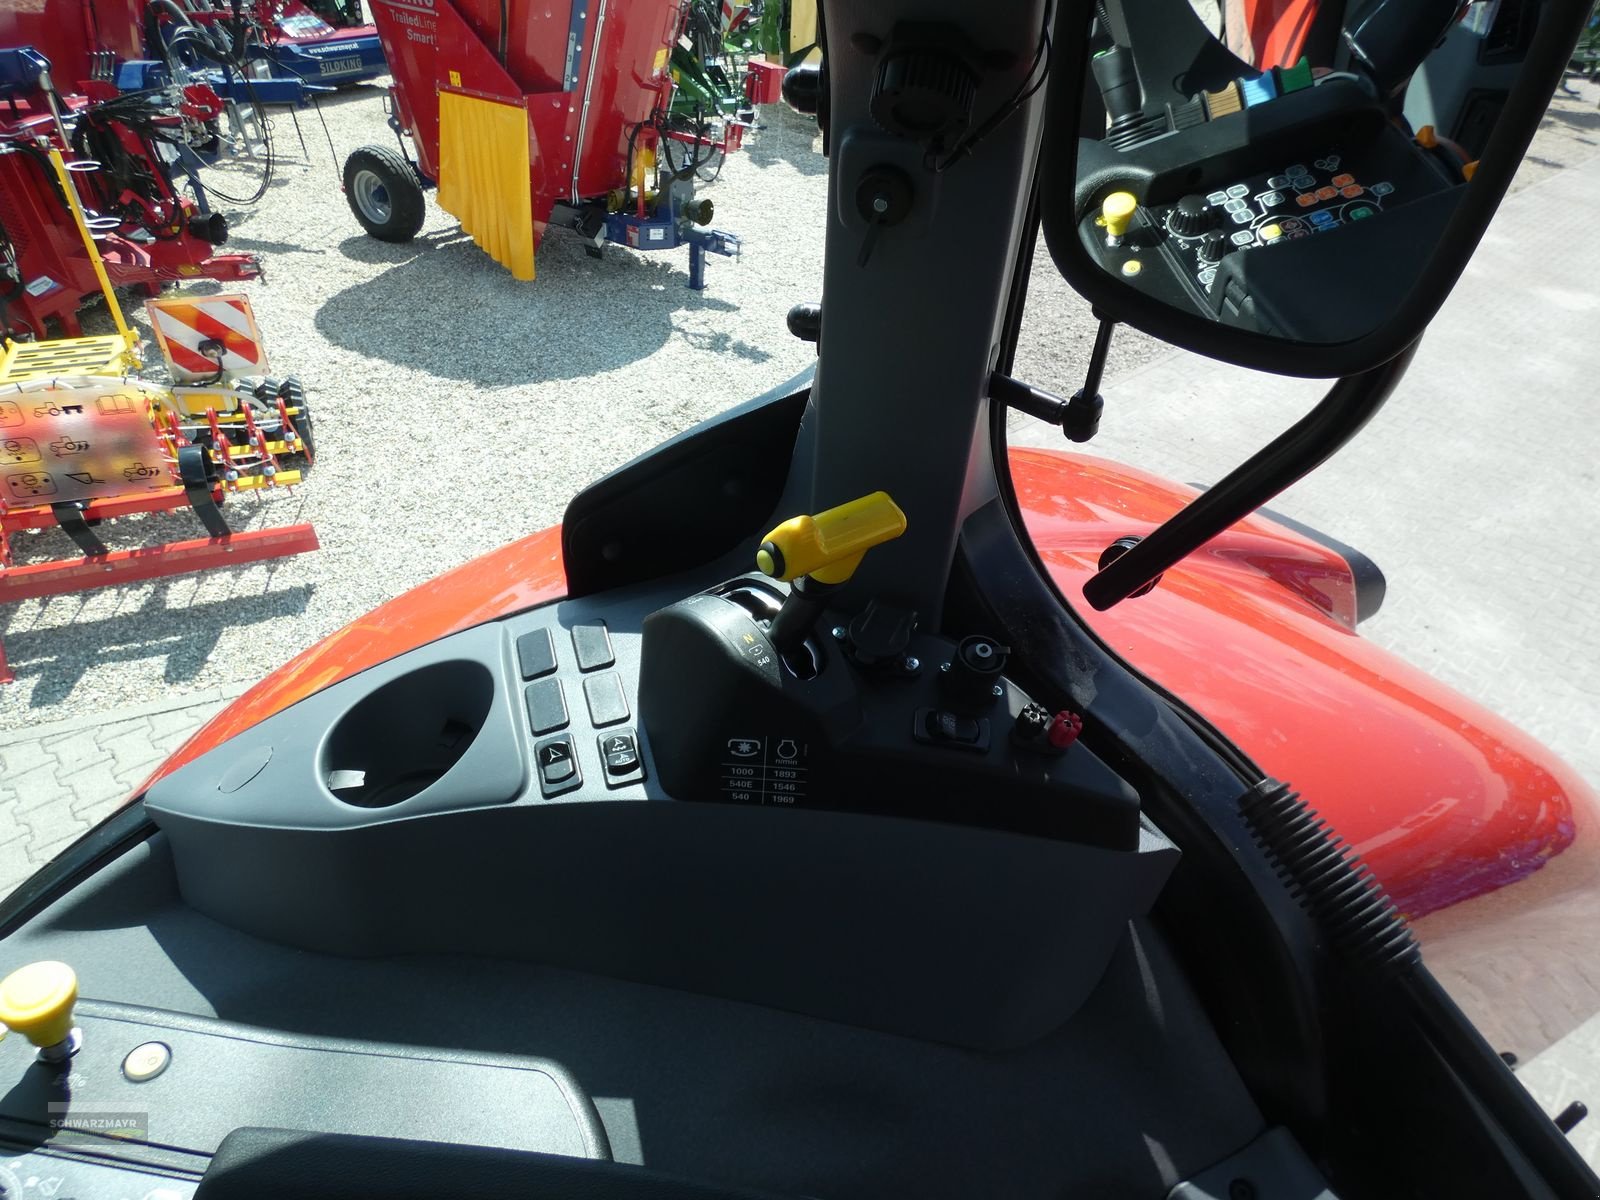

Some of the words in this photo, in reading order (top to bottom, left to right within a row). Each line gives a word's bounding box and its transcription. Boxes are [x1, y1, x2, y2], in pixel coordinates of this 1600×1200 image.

[406, 28, 434, 45] Smart
[320, 58, 362, 73] SILOKING
[742, 633, 754, 644] N
[757, 656, 770, 667] 540
[731, 767, 754, 776] 1000
[774, 770, 796, 779] 1893
[729, 780, 753, 788] 540E
[773, 783, 796, 791] 1546
[732, 792, 750, 800] 540
[772, 795, 795, 803] 1969
